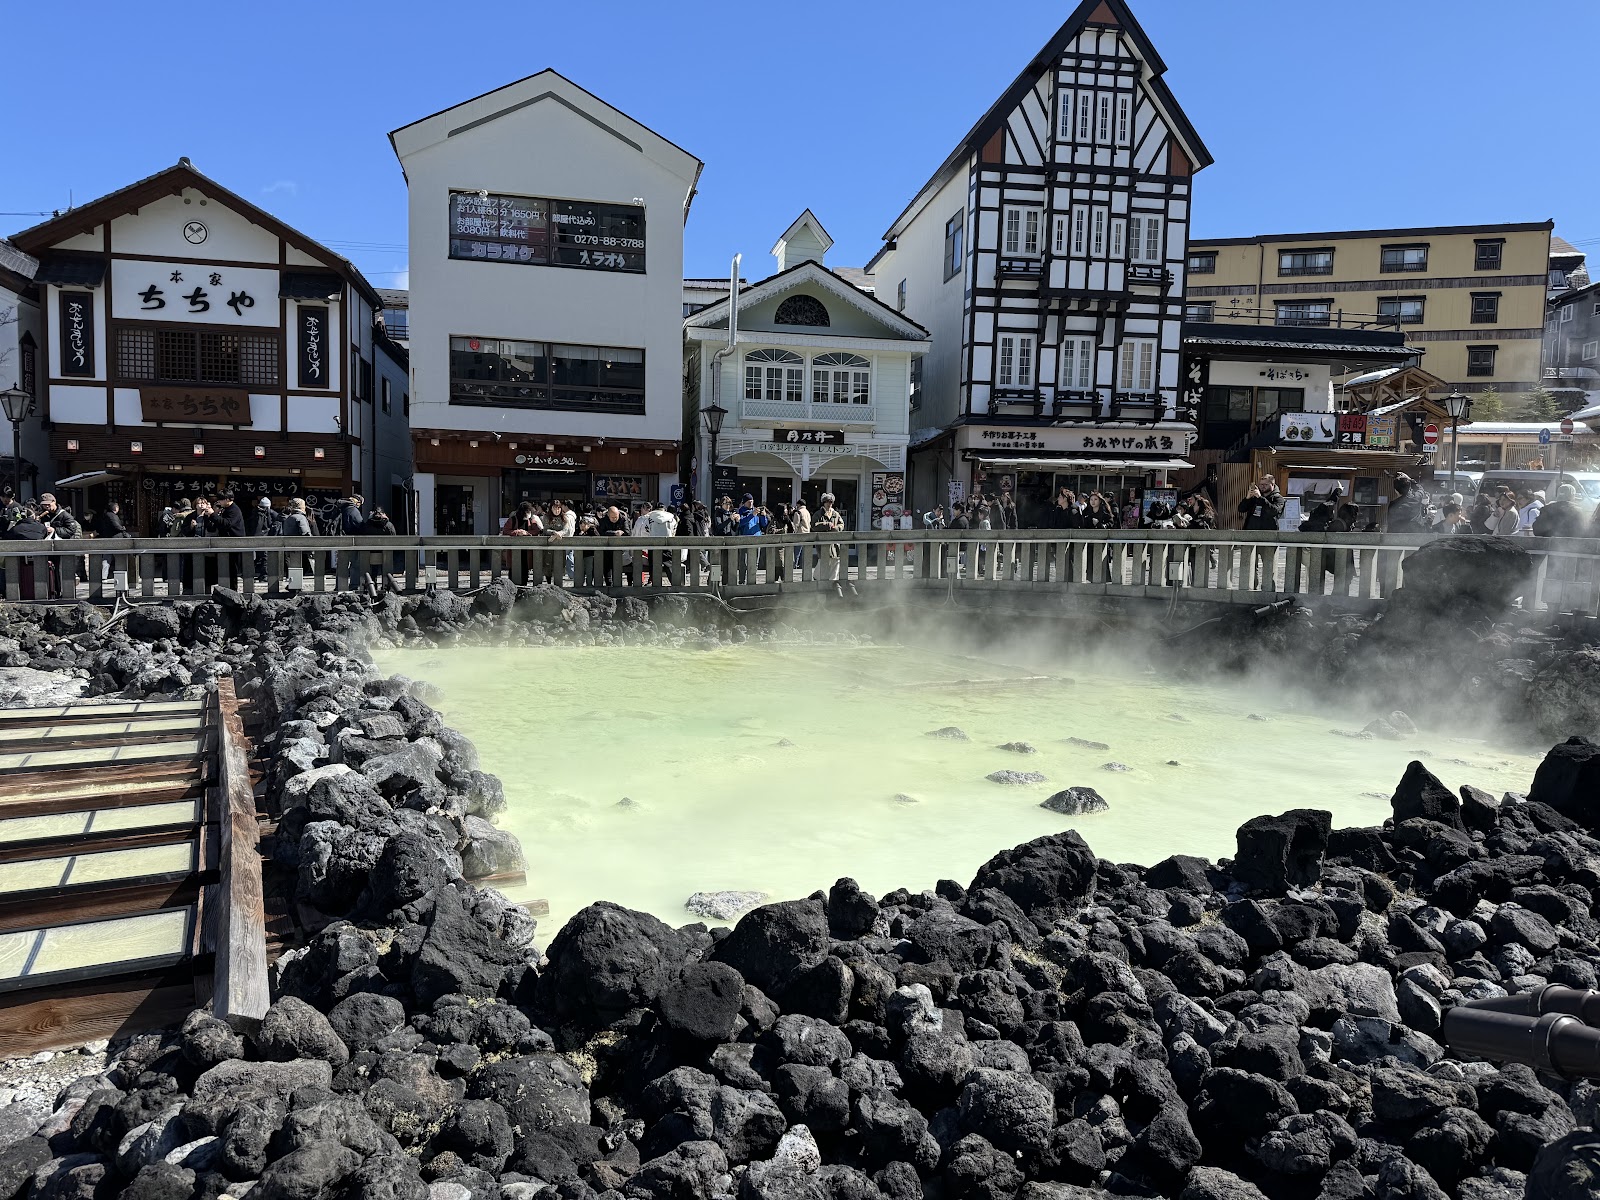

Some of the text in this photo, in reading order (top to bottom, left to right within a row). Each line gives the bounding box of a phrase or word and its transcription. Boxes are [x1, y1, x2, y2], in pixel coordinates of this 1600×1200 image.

[457, 217, 515, 229] お部屋代プラン
[574, 234, 645, 248] 0279-88-3788
[471, 242, 535, 260] カラオケ
[169, 270, 223, 286] 本家
[138, 284, 255, 317] ちちや
[177, 394, 240, 418] ちちや
[1341, 416, 1364, 430] 射的
[1367, 416, 1394, 426] スマート
[981, 430, 1037, 441] 手作りお菓子工房
[1341, 432, 1362, 443] 2階
[1372, 427, 1393, 435] ホール
[1082, 435, 1174, 450] おみやげの本多
[526, 454, 575, 466] うまいもの処
[174, 480, 216, 493] ちちや
